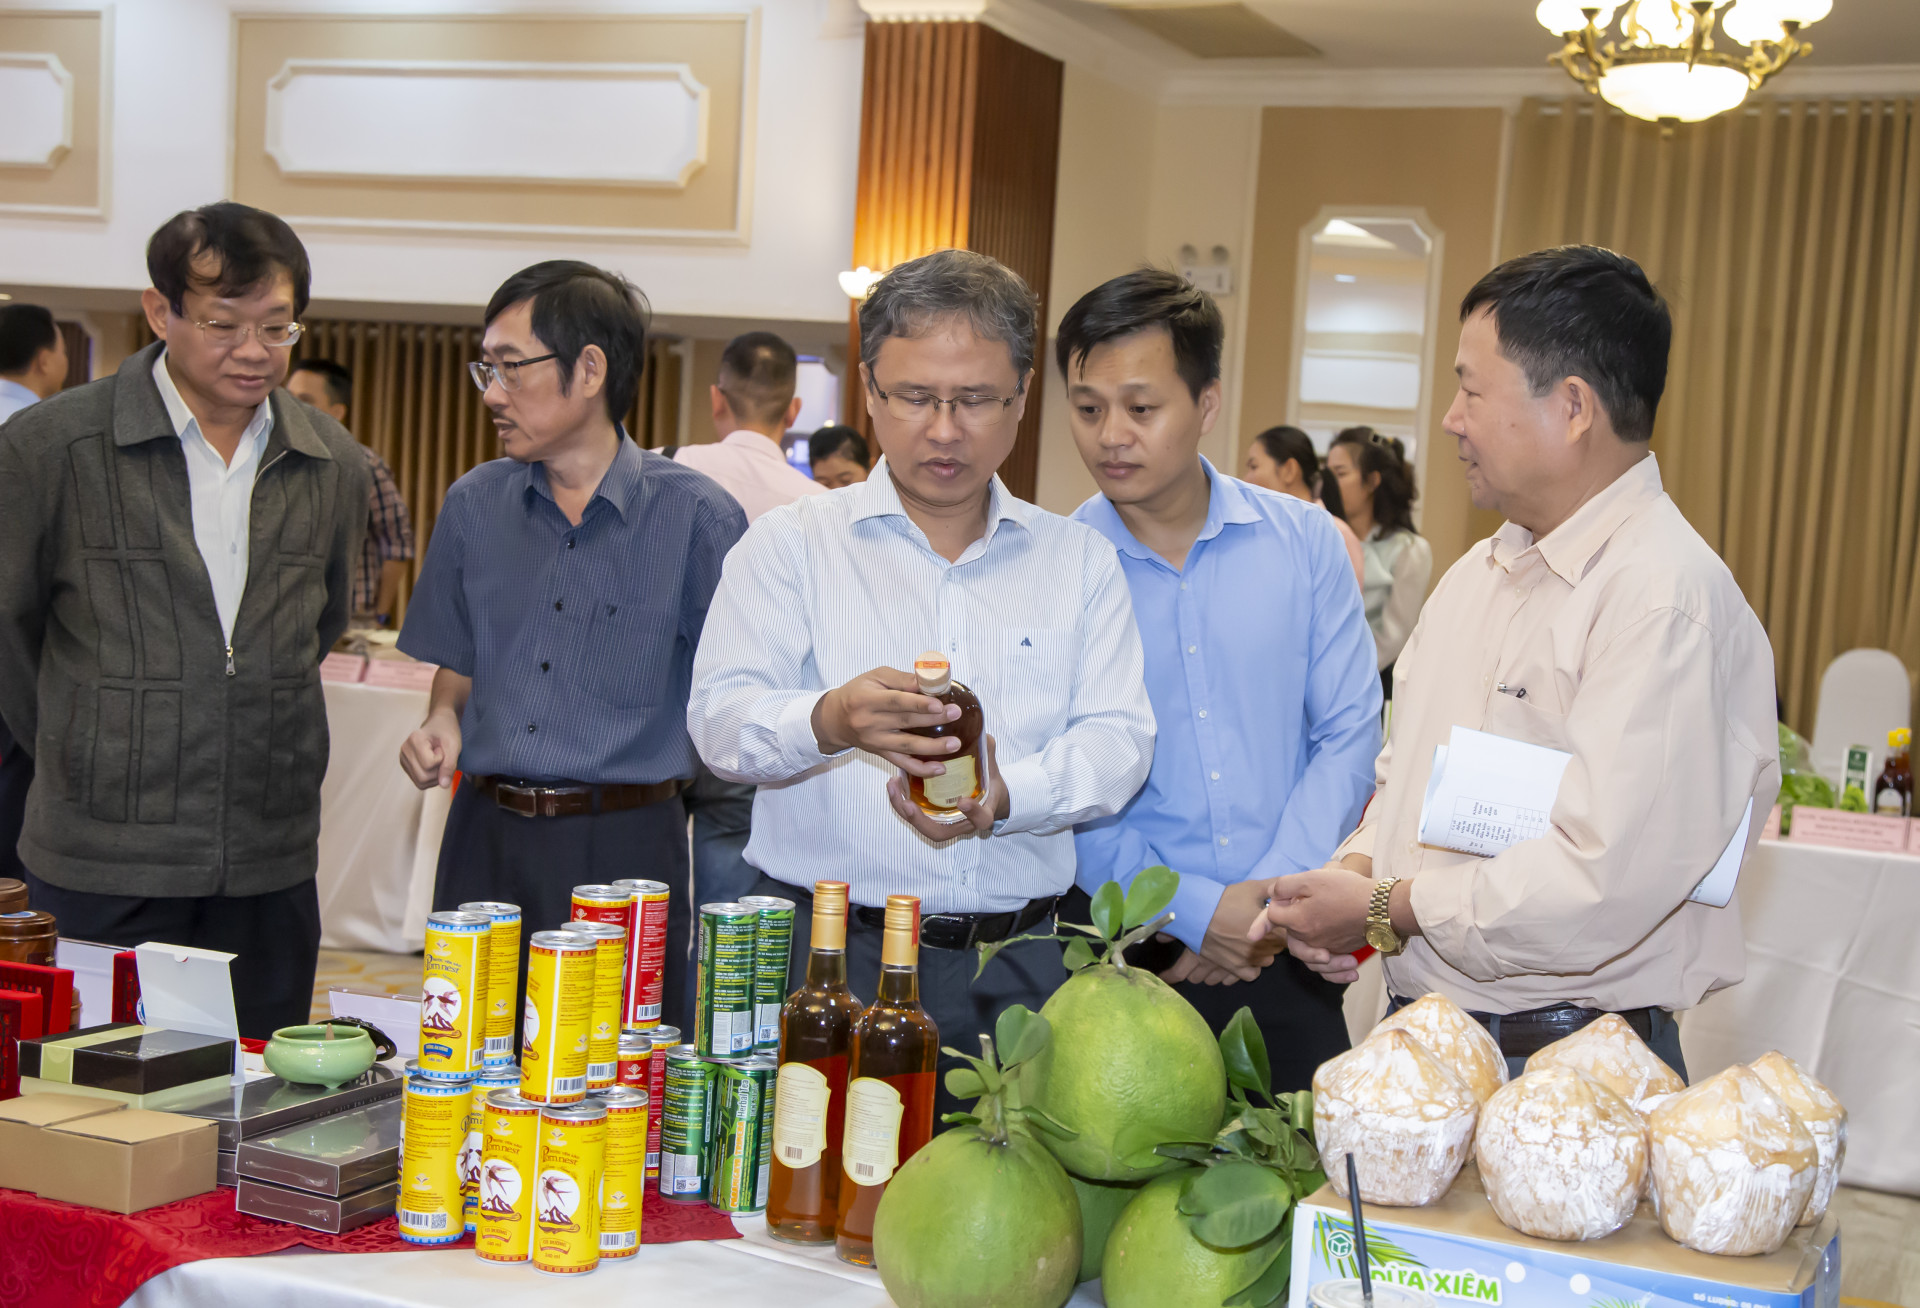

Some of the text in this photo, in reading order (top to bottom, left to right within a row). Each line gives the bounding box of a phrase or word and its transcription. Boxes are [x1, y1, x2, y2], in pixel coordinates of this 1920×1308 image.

[740, 1079, 749, 1092] Tea
[737, 1094, 748, 1117] Herbal
[1434, 1273, 1498, 1302] XIÊM
